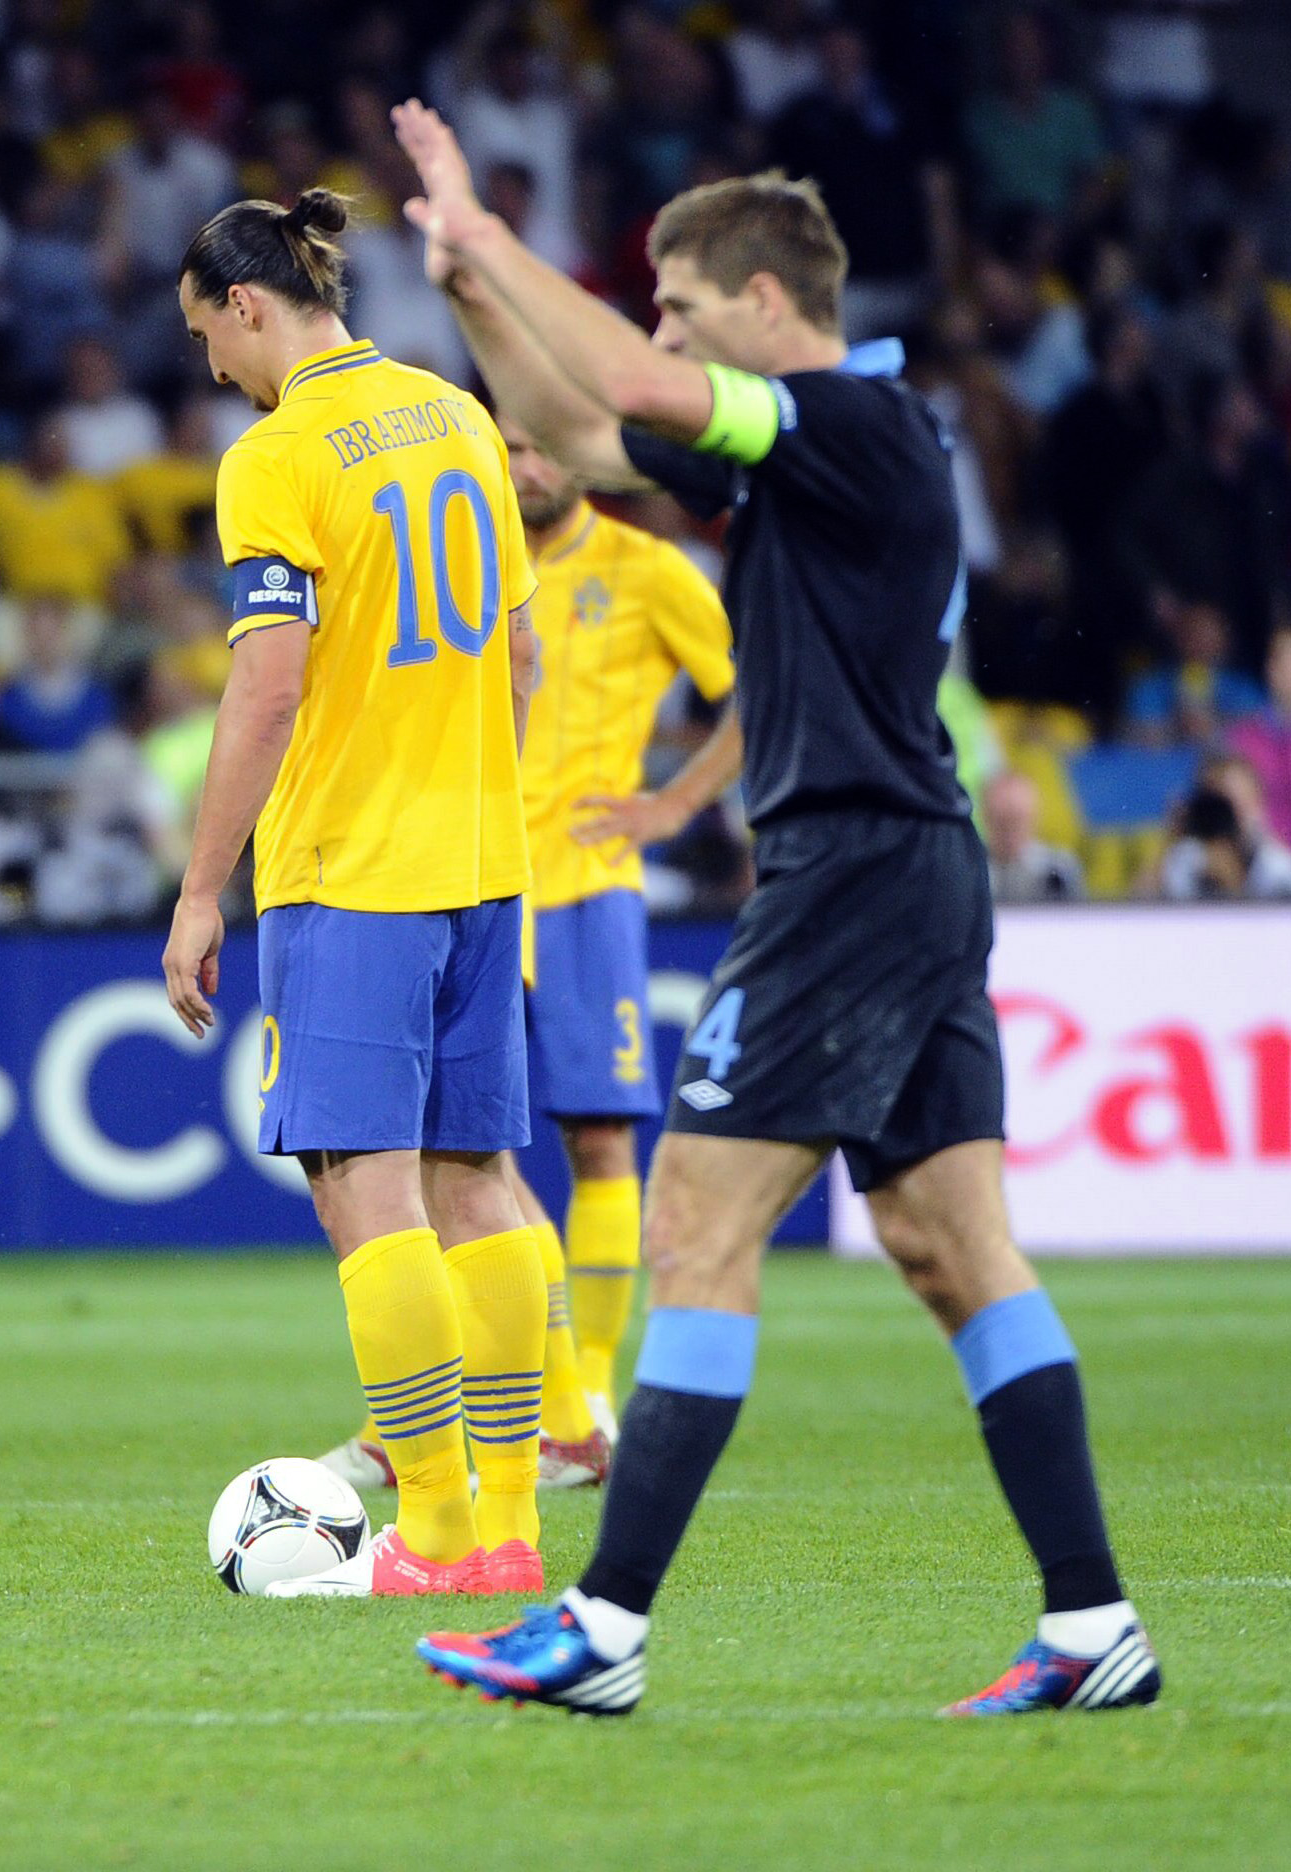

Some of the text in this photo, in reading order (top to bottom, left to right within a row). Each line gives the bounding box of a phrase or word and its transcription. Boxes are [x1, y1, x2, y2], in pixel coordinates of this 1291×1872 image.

[324, 398, 479, 469] IBRAHIMOVI
[248, 589, 303, 605] RESPECT
[373, 469, 500, 668] 10
[614, 998, 641, 1063] 3
[686, 986, 745, 1081] 4
